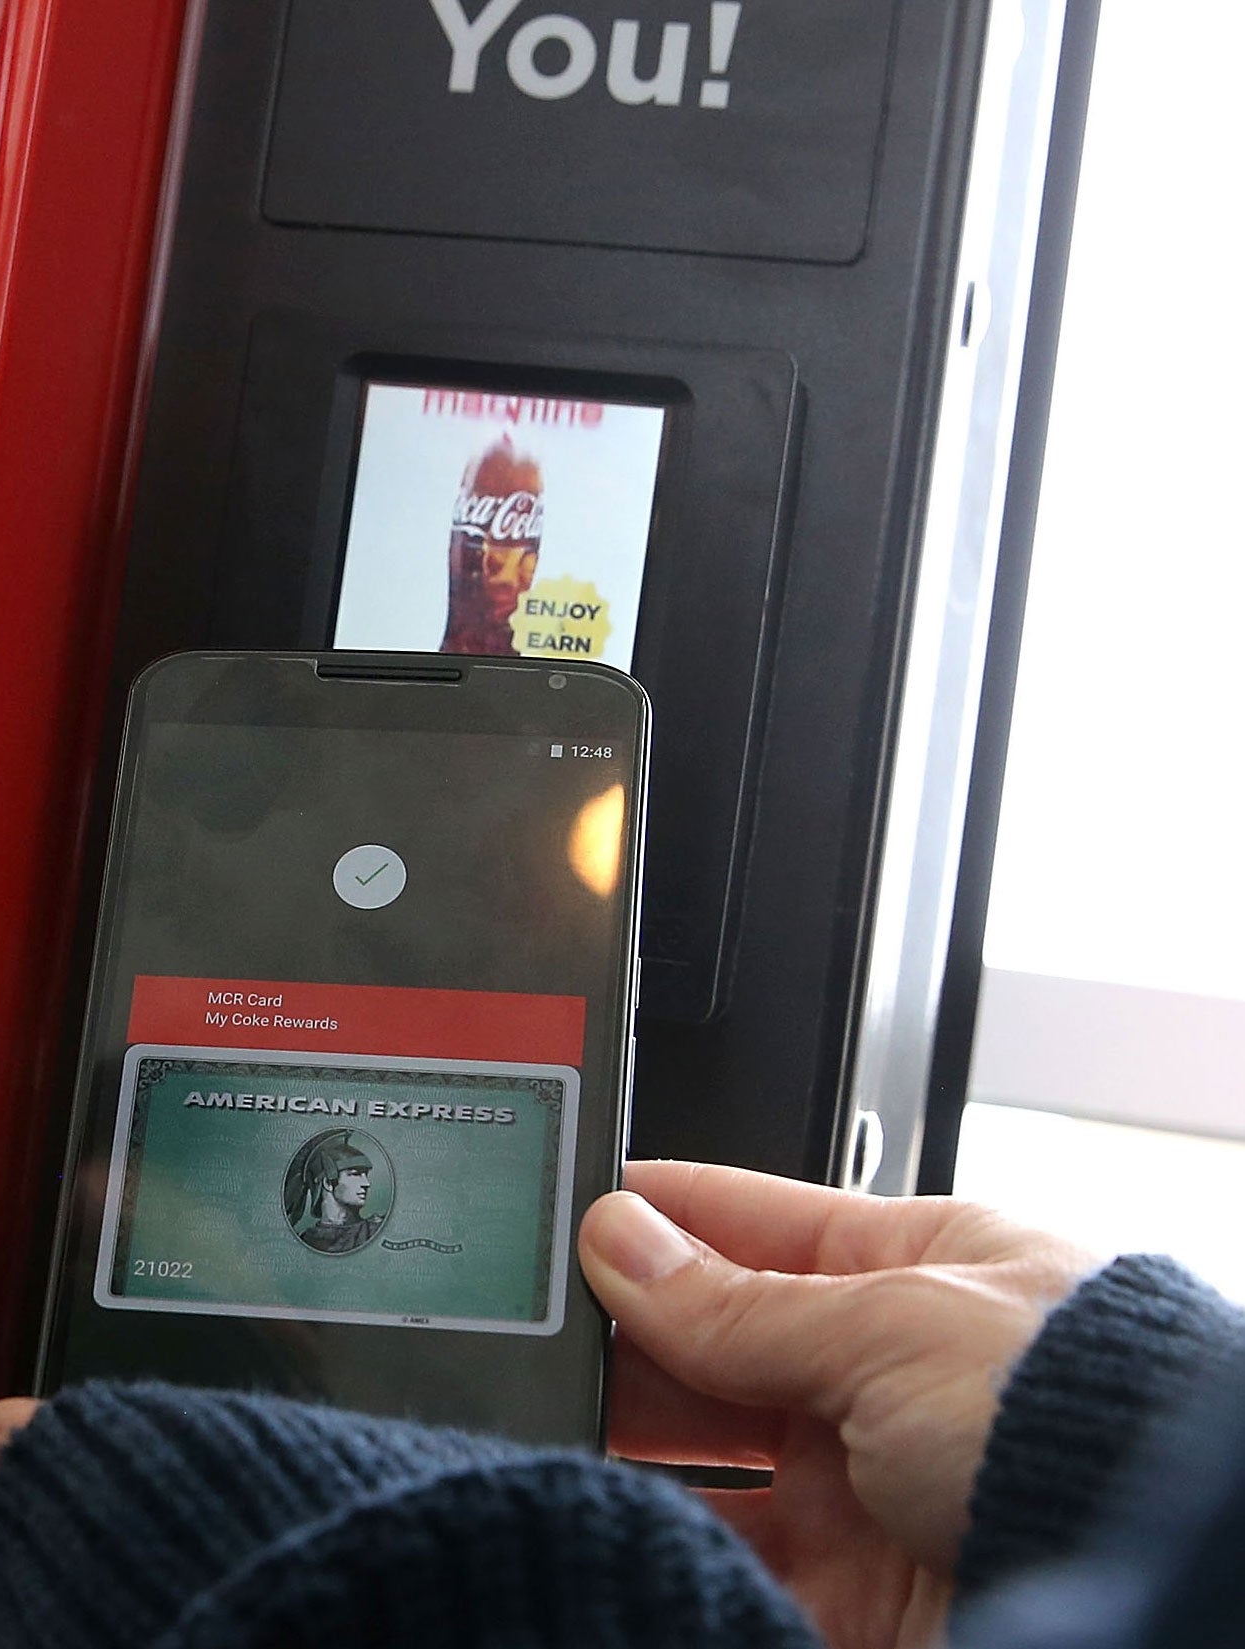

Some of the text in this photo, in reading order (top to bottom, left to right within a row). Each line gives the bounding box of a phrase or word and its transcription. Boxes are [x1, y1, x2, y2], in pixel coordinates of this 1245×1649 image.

[429, 0, 741, 109] You!
[525, 599, 601, 621] ENJOY
[527, 632, 592, 653] EARN
[571, 745, 613, 759] 12:48
[207, 992, 283, 1008] MCR Card
[205, 1011, 339, 1031] My Coke Rewards
[183, 1090, 517, 1124] AMERICAN EXPRESS
[133, 1260, 193, 1279] 21022
